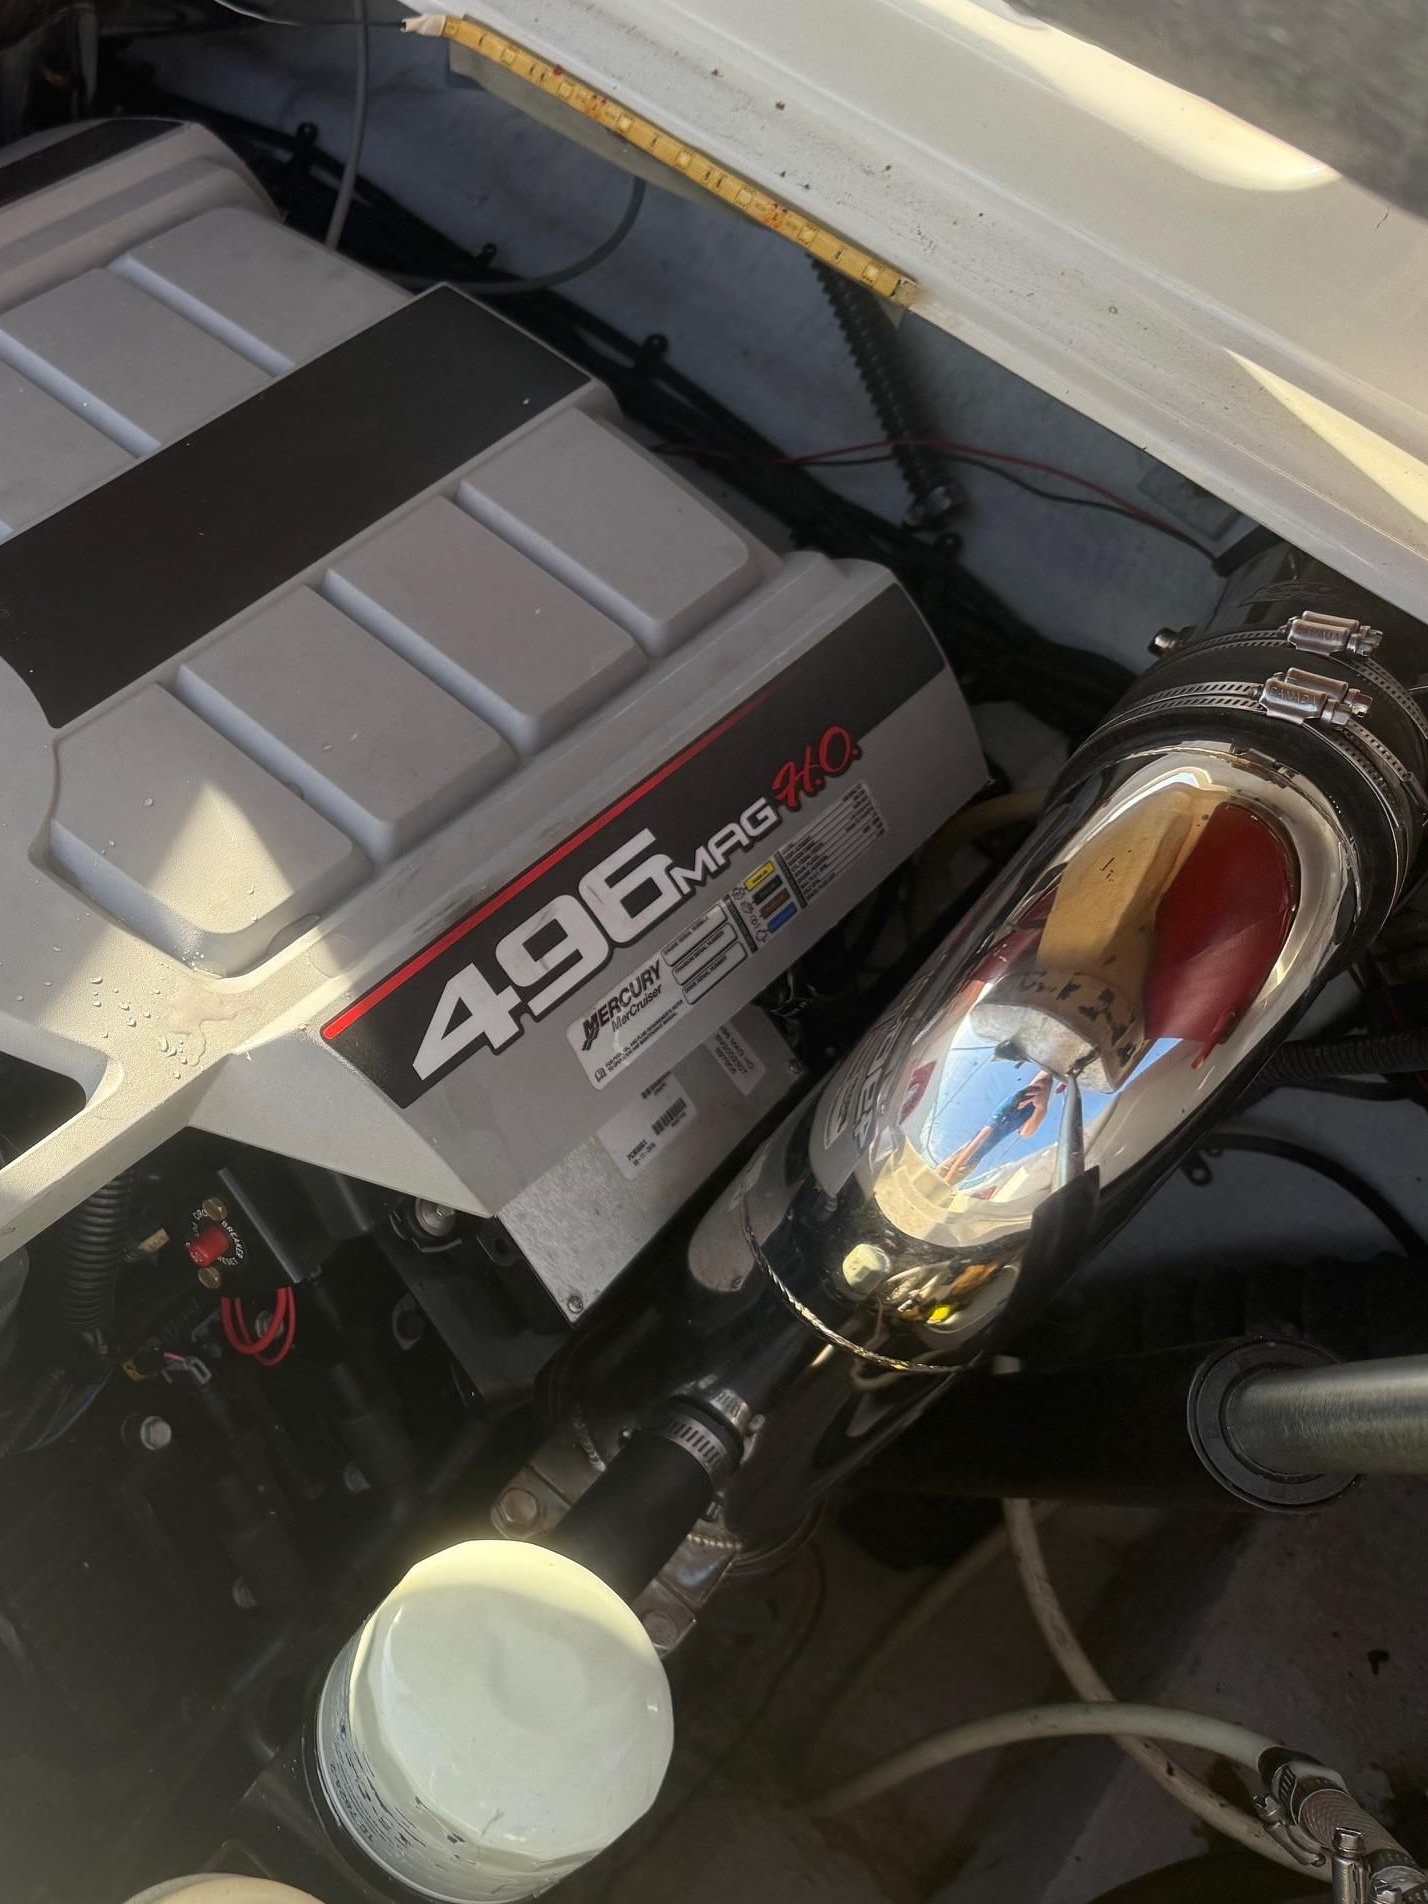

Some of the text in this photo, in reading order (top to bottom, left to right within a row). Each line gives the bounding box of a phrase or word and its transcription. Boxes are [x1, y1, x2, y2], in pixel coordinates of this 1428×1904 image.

[412, 827, 682, 1081] 496
[670, 797, 779, 896] MAG
[582, 959, 660, 1050] MERCURY
[612, 984, 661, 1032] MerCruiser
